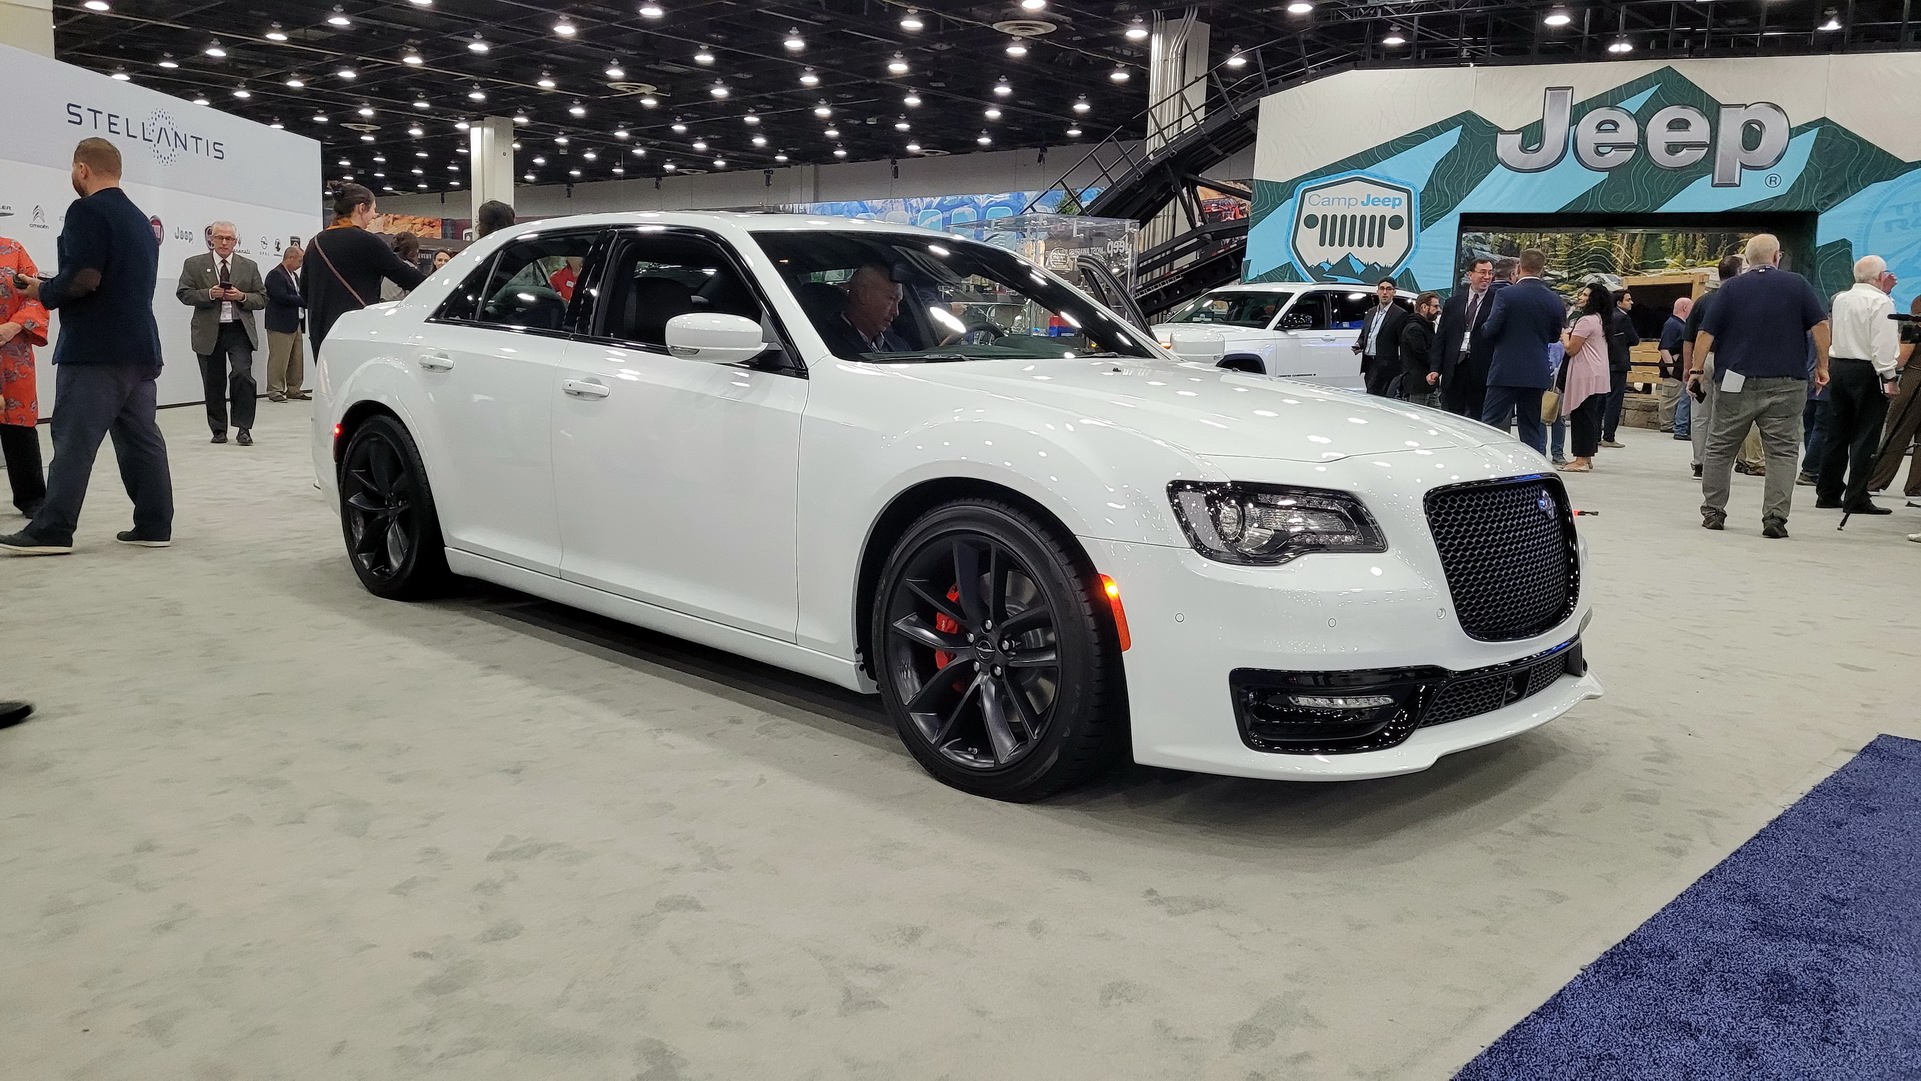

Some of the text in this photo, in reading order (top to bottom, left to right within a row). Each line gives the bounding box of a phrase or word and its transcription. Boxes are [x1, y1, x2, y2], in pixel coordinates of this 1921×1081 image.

[67, 103, 225, 160] STELLANTIS
[1496, 86, 1791, 187] Jeep
[1308, 193, 1403, 209] Camp Jeep
[174, 226, 194, 244] Jeep
